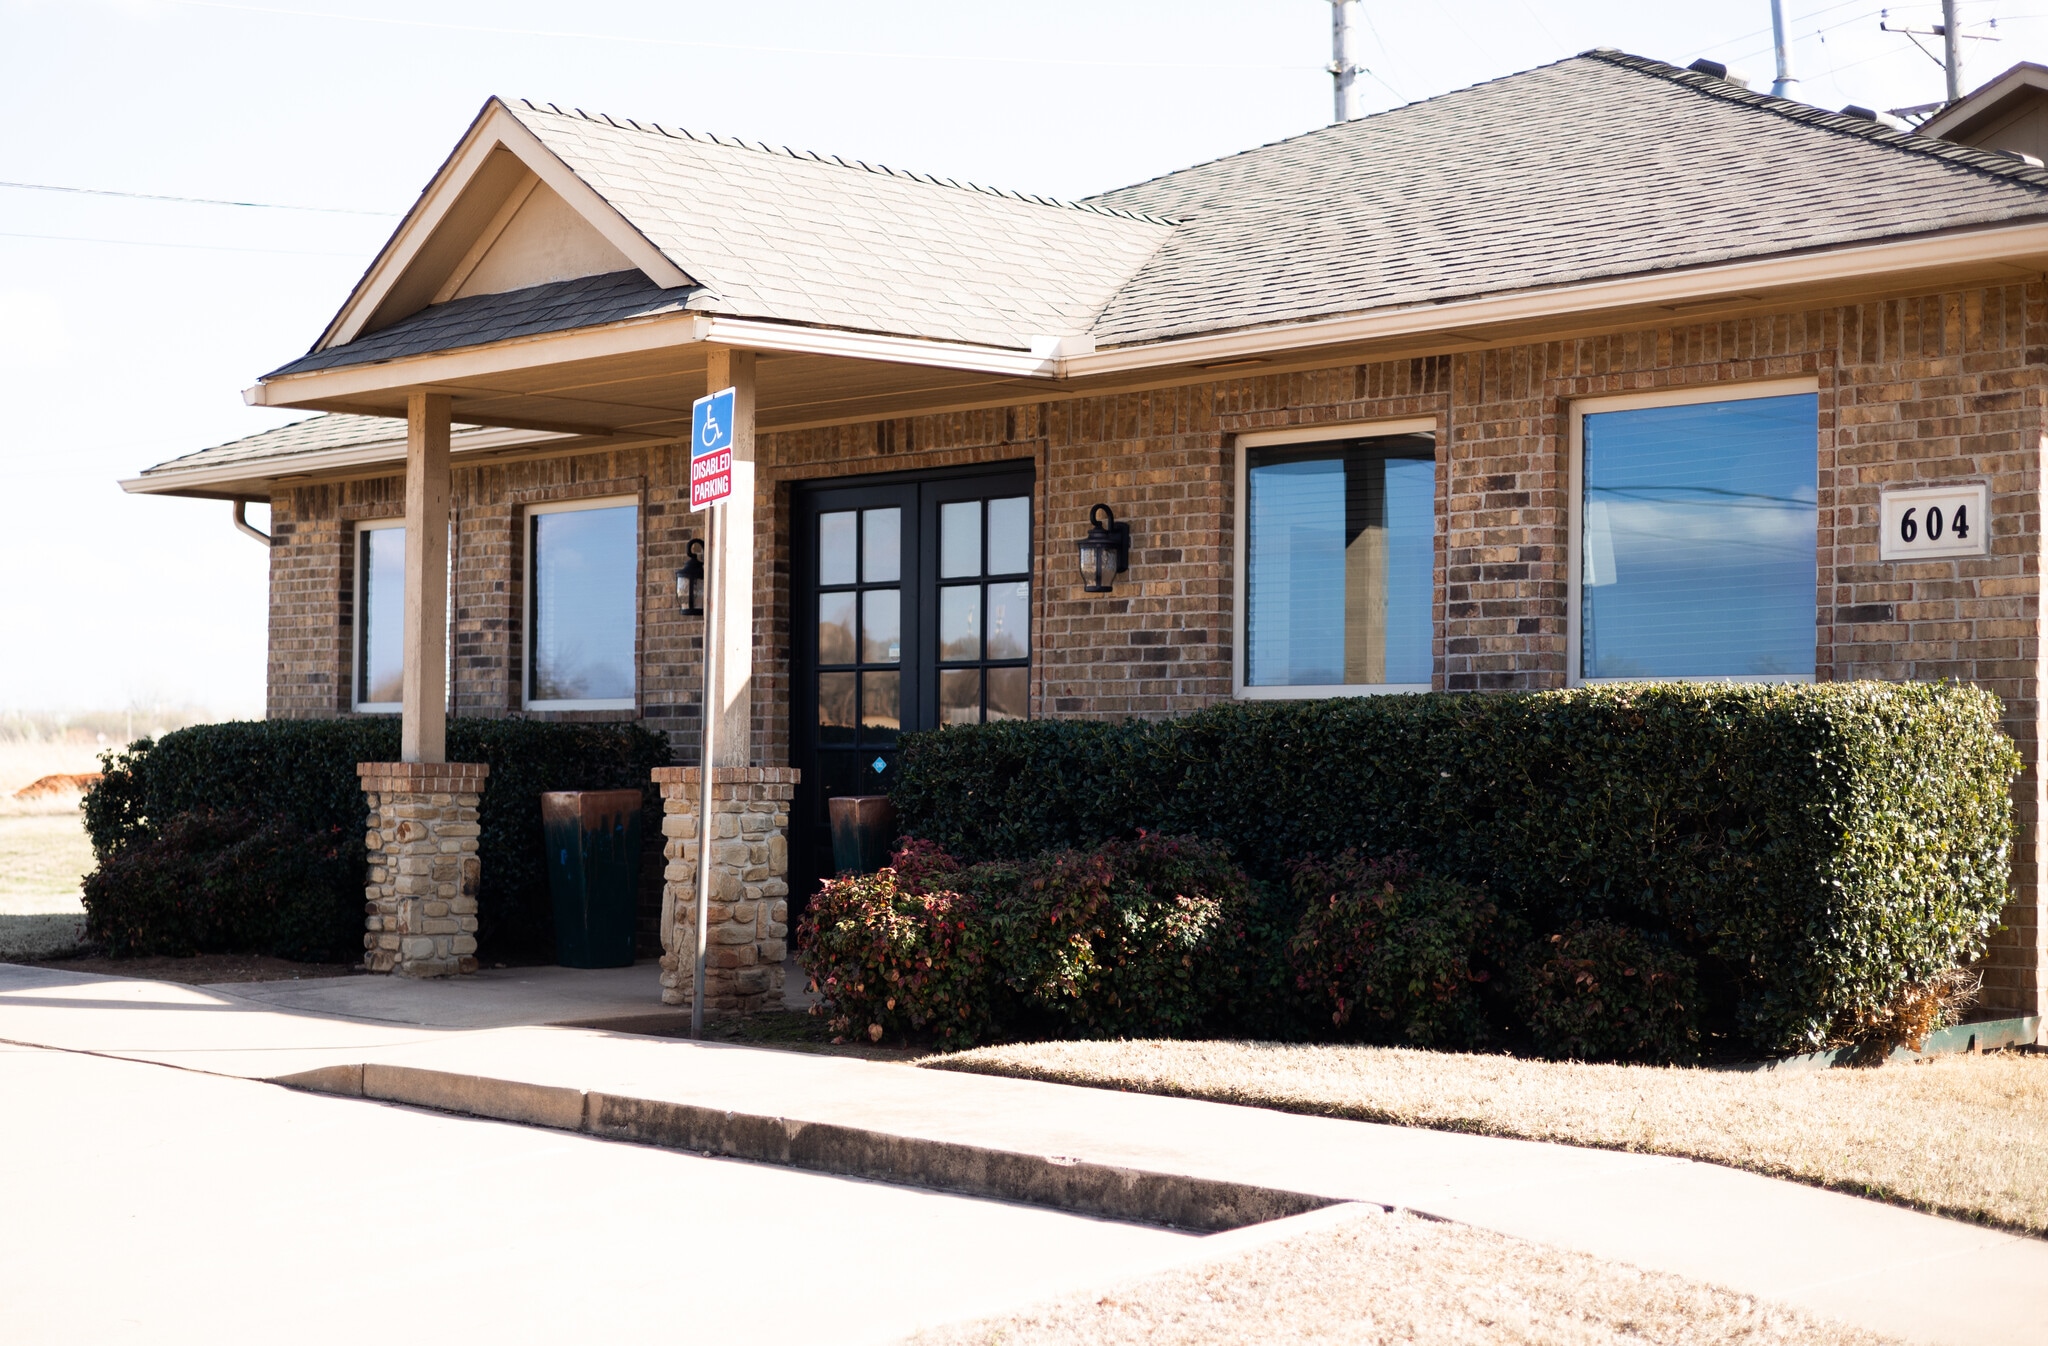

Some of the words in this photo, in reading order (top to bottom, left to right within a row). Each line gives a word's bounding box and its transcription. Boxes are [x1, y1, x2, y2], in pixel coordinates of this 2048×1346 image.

[694, 453, 730, 480] DISABLED
[695, 475, 729, 502] PARKING
[1901, 505, 1969, 543] 604
